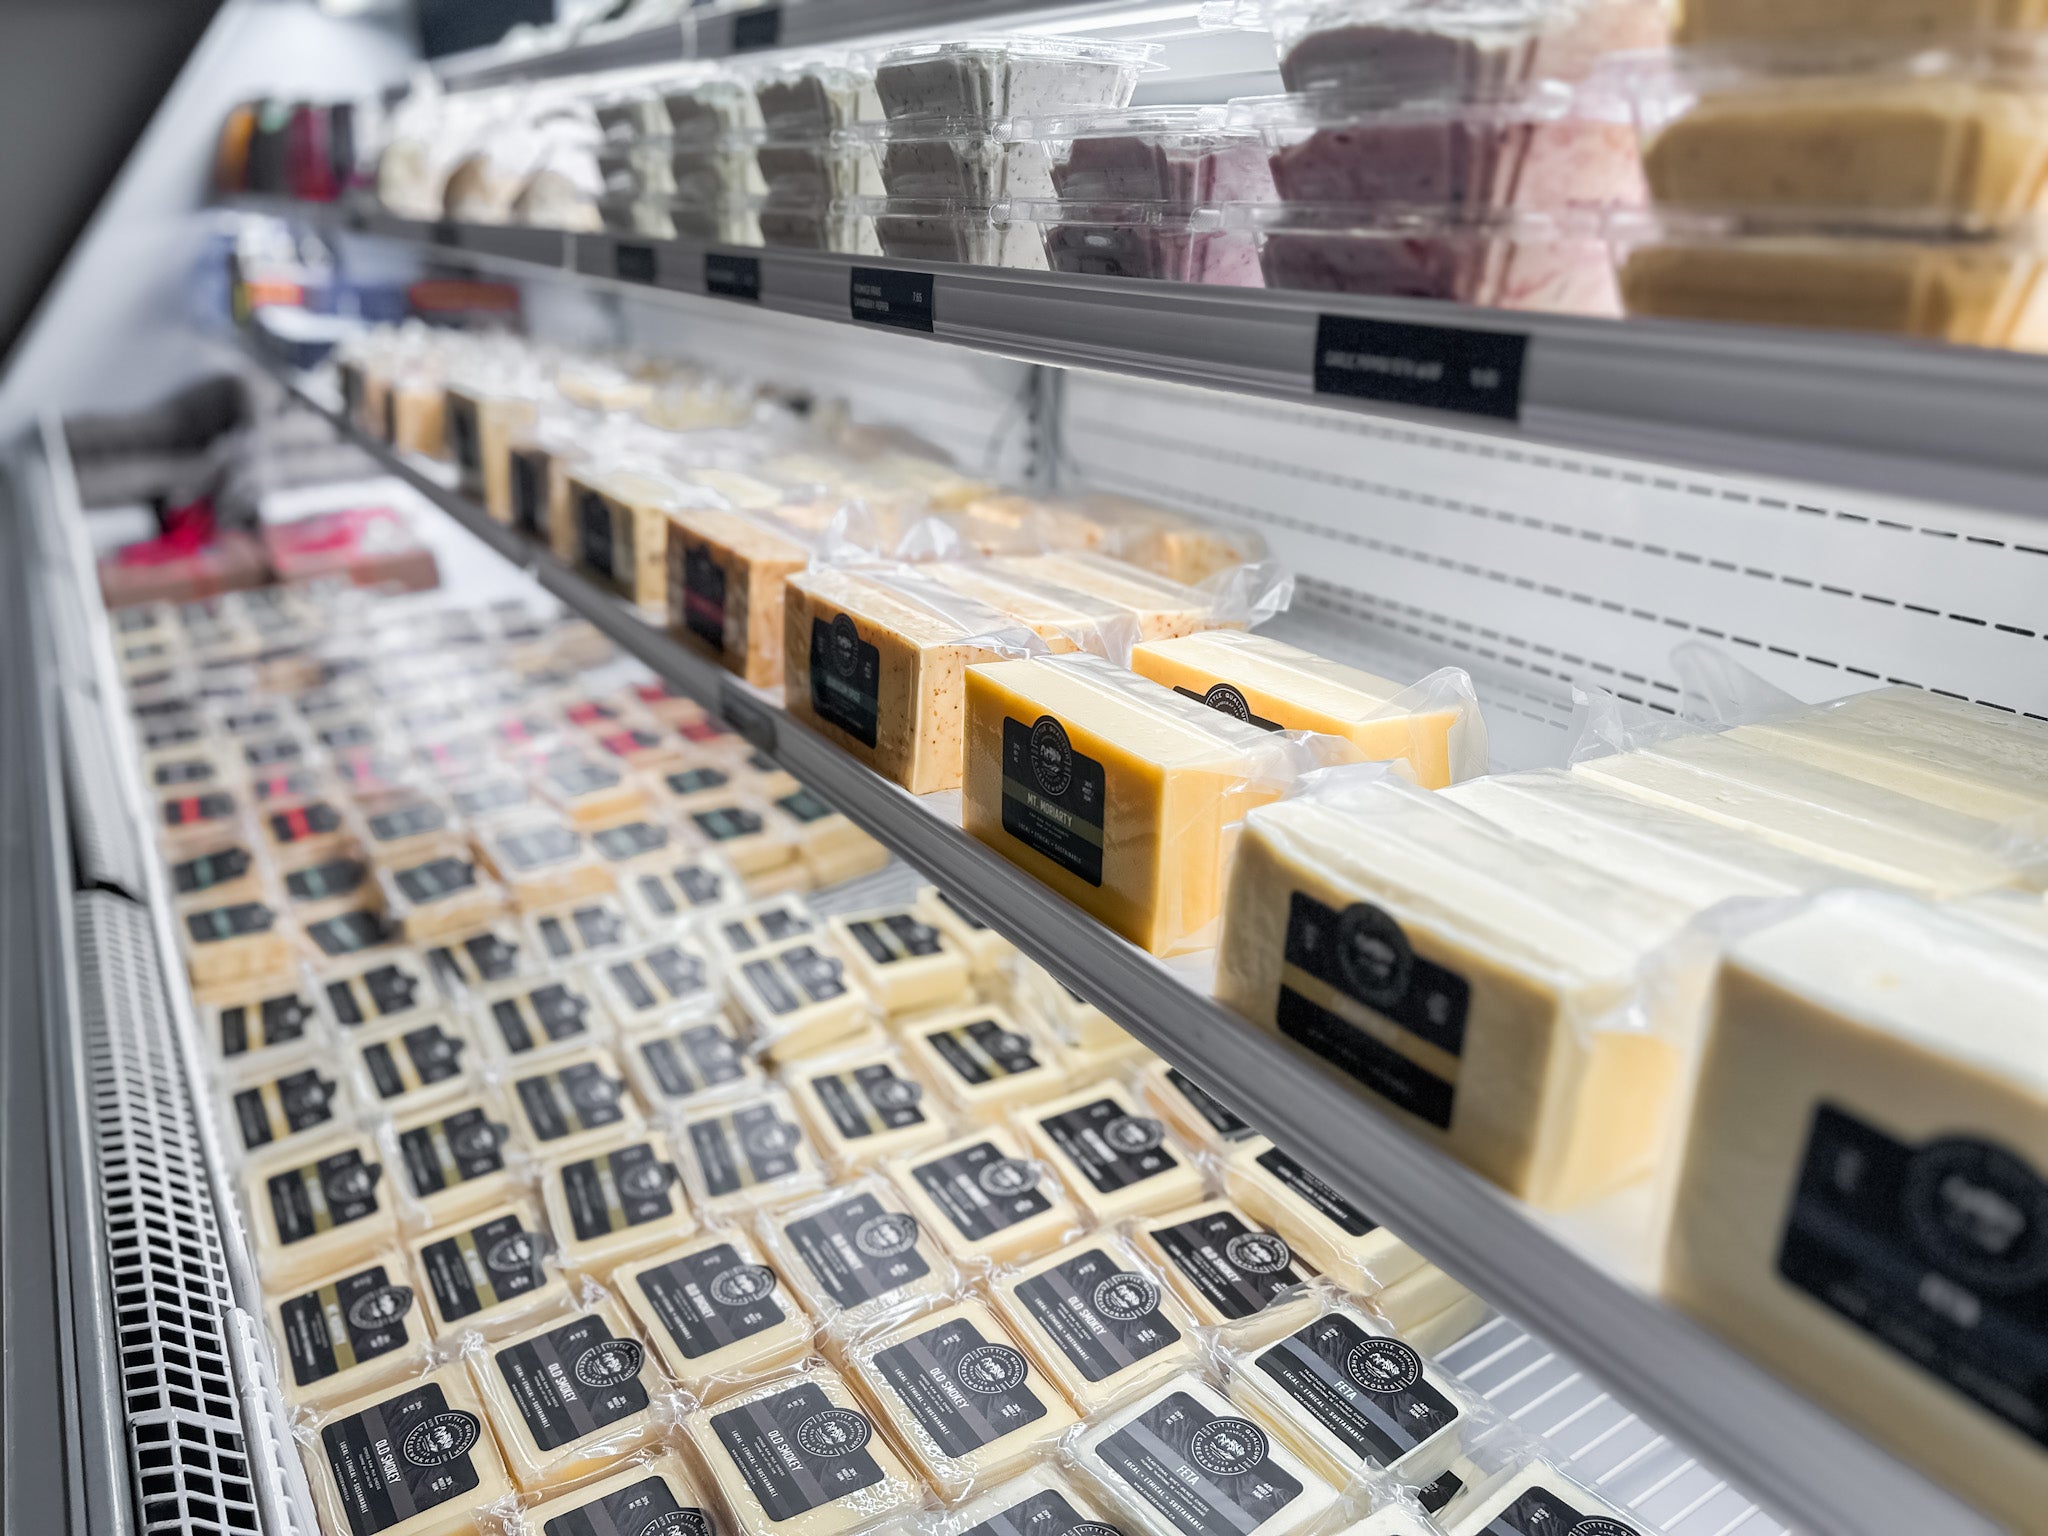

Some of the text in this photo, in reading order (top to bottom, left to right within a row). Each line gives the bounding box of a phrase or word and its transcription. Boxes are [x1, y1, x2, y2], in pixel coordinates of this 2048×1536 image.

[1209, 693, 1222, 706] ITTLE
[1040, 798, 1072, 827] MORIARTY
[1079, 1309, 1106, 1334] SMOKEY
[548, 1363, 577, 1401] OLD SMOKEY
[578, 1353, 609, 1385] CHEESEWORKS
[960, 1358, 996, 1391] CHEESEWORKS
[982, 1348, 1023, 1384] LITTLE QUALICUM
[1350, 1355, 1396, 1390] CHEESEWORKS
[1399, 1350, 1415, 1380] QUALICUM
[514, 1364, 550, 1427] LOCAL ETHICAL SUSTAINABLE
[895, 1368, 950, 1434] LOCAL ETHICAL SUSTAINABLE
[929, 1367, 969, 1408] OLD SMOKEY
[1334, 1380, 1357, 1400] FETA
[1282, 1370, 1364, 1441] LOCAL ETHICAL SUSTAINABLE
[406, 1426, 436, 1464] CHEESEWORKS
[439, 1416, 472, 1455] LITTLE QUALICUM
[767, 1429, 803, 1470] OLD SMOKEY
[800, 1421, 834, 1455] CHEESEWORKS
[849, 1421, 863, 1449] QUALICUM
[1245, 1430, 1261, 1460] QUALICUM
[375, 1439, 401, 1483] OLD SMOKEY
[731, 1430, 778, 1497] LOCAL ETHICAL SUSTAINABLE
[1194, 1437, 1239, 1472] CHEESEWORKS
[339, 1441, 368, 1513] LOCAL ETHICAL SUSTAINABLE
[1176, 1465, 1199, 1485] FETA
[1123, 1459, 1204, 1530] LOCAL ETHICAL SUSTAINABLE
[671, 1514, 699, 1523] LITTLE
[1080, 1527, 1110, 1535] LITTLE
